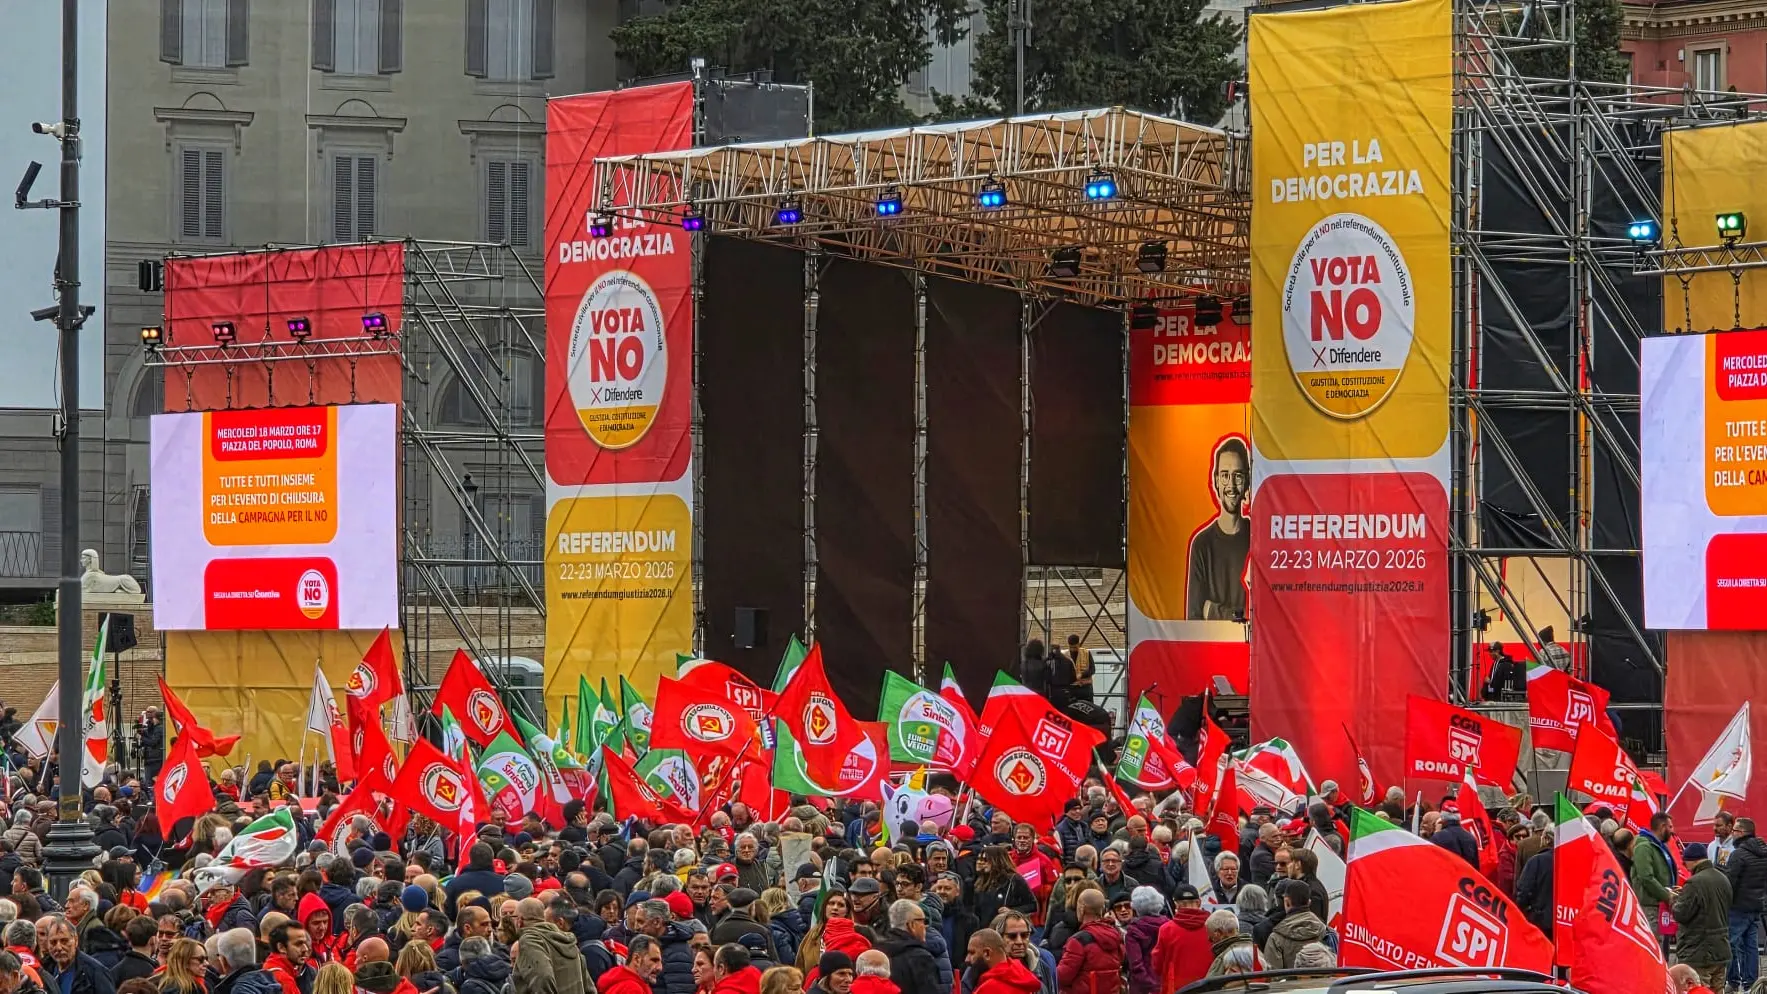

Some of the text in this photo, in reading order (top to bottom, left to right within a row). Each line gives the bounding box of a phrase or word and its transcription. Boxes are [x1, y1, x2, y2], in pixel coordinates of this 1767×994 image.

[1304, 139, 1383, 168] PER LA
[1271, 169, 1424, 204] DEMOCRAZIA
[623, 209, 645, 229] LA
[559, 232, 674, 263] DEMOCRAZIA
[1284, 219, 1411, 312] Società civile per il NO nel referendum costituzionale
[1310, 255, 1381, 286] VOTA
[597, 280, 607, 291] NO
[607, 276, 616, 286] nel
[616, 276, 647, 298] referendum
[590, 307, 645, 334] VOTA
[1310, 287, 1382, 342] NO
[1154, 316, 1189, 337] PER
[589, 335, 645, 382] NO
[1329, 347, 1382, 364] Difendere
[1341, 376, 1385, 386] COSTITUZIONE
[1728, 373, 1760, 388] PIAZZA
[604, 386, 643, 402] Difendere
[1331, 389, 1370, 398] DEMOCRAZIA
[217, 425, 322, 439] MERCOLEDÌ 18 MARZO ORE 17
[1726, 420, 1767, 437] TUTTE E
[221, 438, 317, 452] PIAZZA DEL POPOLO, ROMA
[1715, 446, 1734, 462] PER
[219, 474, 315, 488] TUTTE E TUTTI INSIEME
[1714, 470, 1745, 486] DELLA
[211, 491, 325, 506] PER L'EVENTO DI CHIUSURA
[211, 509, 328, 524] DELLA CAMPAGNA PER IL NO
[1270, 514, 1426, 539] REFERENDUM
[558, 530, 676, 554] REFERENDUM
[1270, 550, 1426, 569] 22-23 MARZO 2026
[560, 561, 674, 580] 22-23 MARZO 2026
[304, 580, 321, 588] VOTA
[1270, 580, 1424, 594] www.referendumgiustizia2026.it
[304, 588, 321, 601] NO
[561, 588, 673, 600] www.referendumgiustizia2026.it
[733, 688, 758, 706] SPI
[1571, 702, 1593, 722] SPI
[1038, 731, 1063, 753] SPI
[1451, 740, 1478, 764] SPI
[1415, 760, 1459, 776] ROMA
[1584, 780, 1628, 798] ROMA
[1458, 877, 1508, 923] CGIL
[1595, 869, 1620, 921] CGIL
[1556, 905, 1579, 922] SIN
[1452, 921, 1498, 968] SPI
